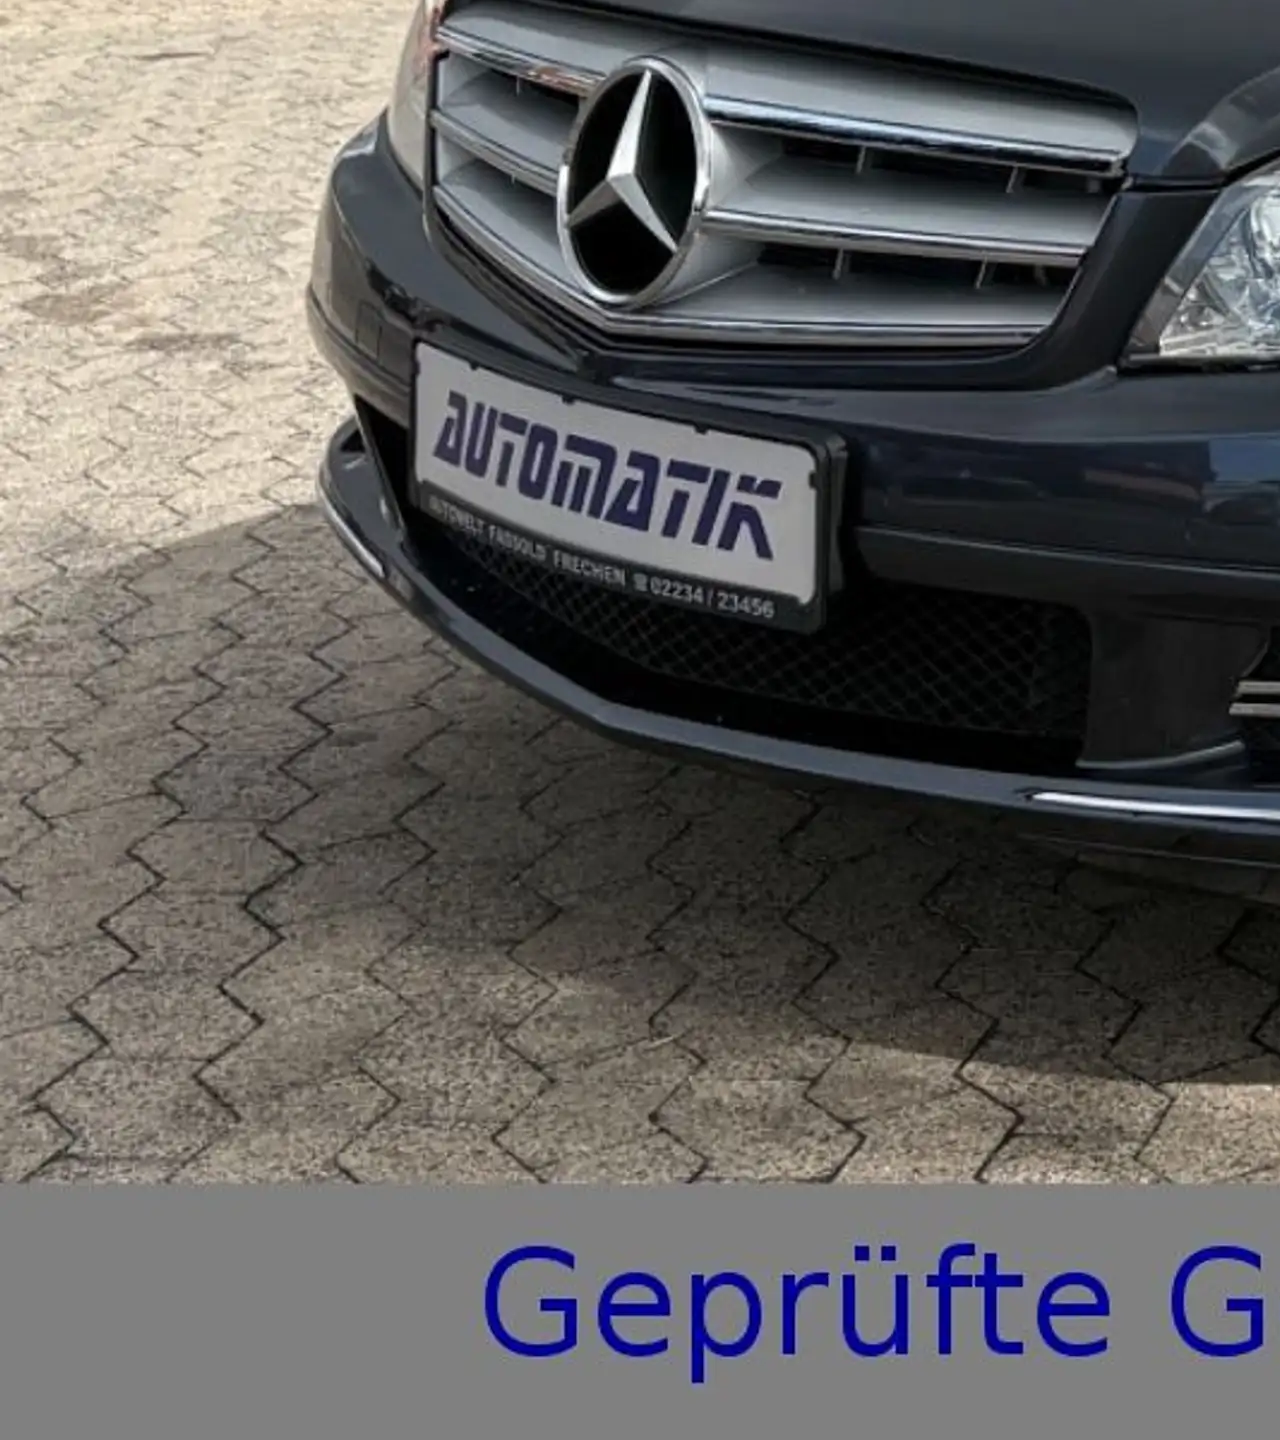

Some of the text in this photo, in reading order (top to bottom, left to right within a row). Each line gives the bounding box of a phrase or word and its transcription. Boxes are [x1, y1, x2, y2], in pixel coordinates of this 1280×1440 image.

[433, 390, 783, 561] AUTOMATIK
[553, 550, 626, 588] FRECHEN
[650, 576, 703, 604] 02234
[717, 591, 776, 619] 23456
